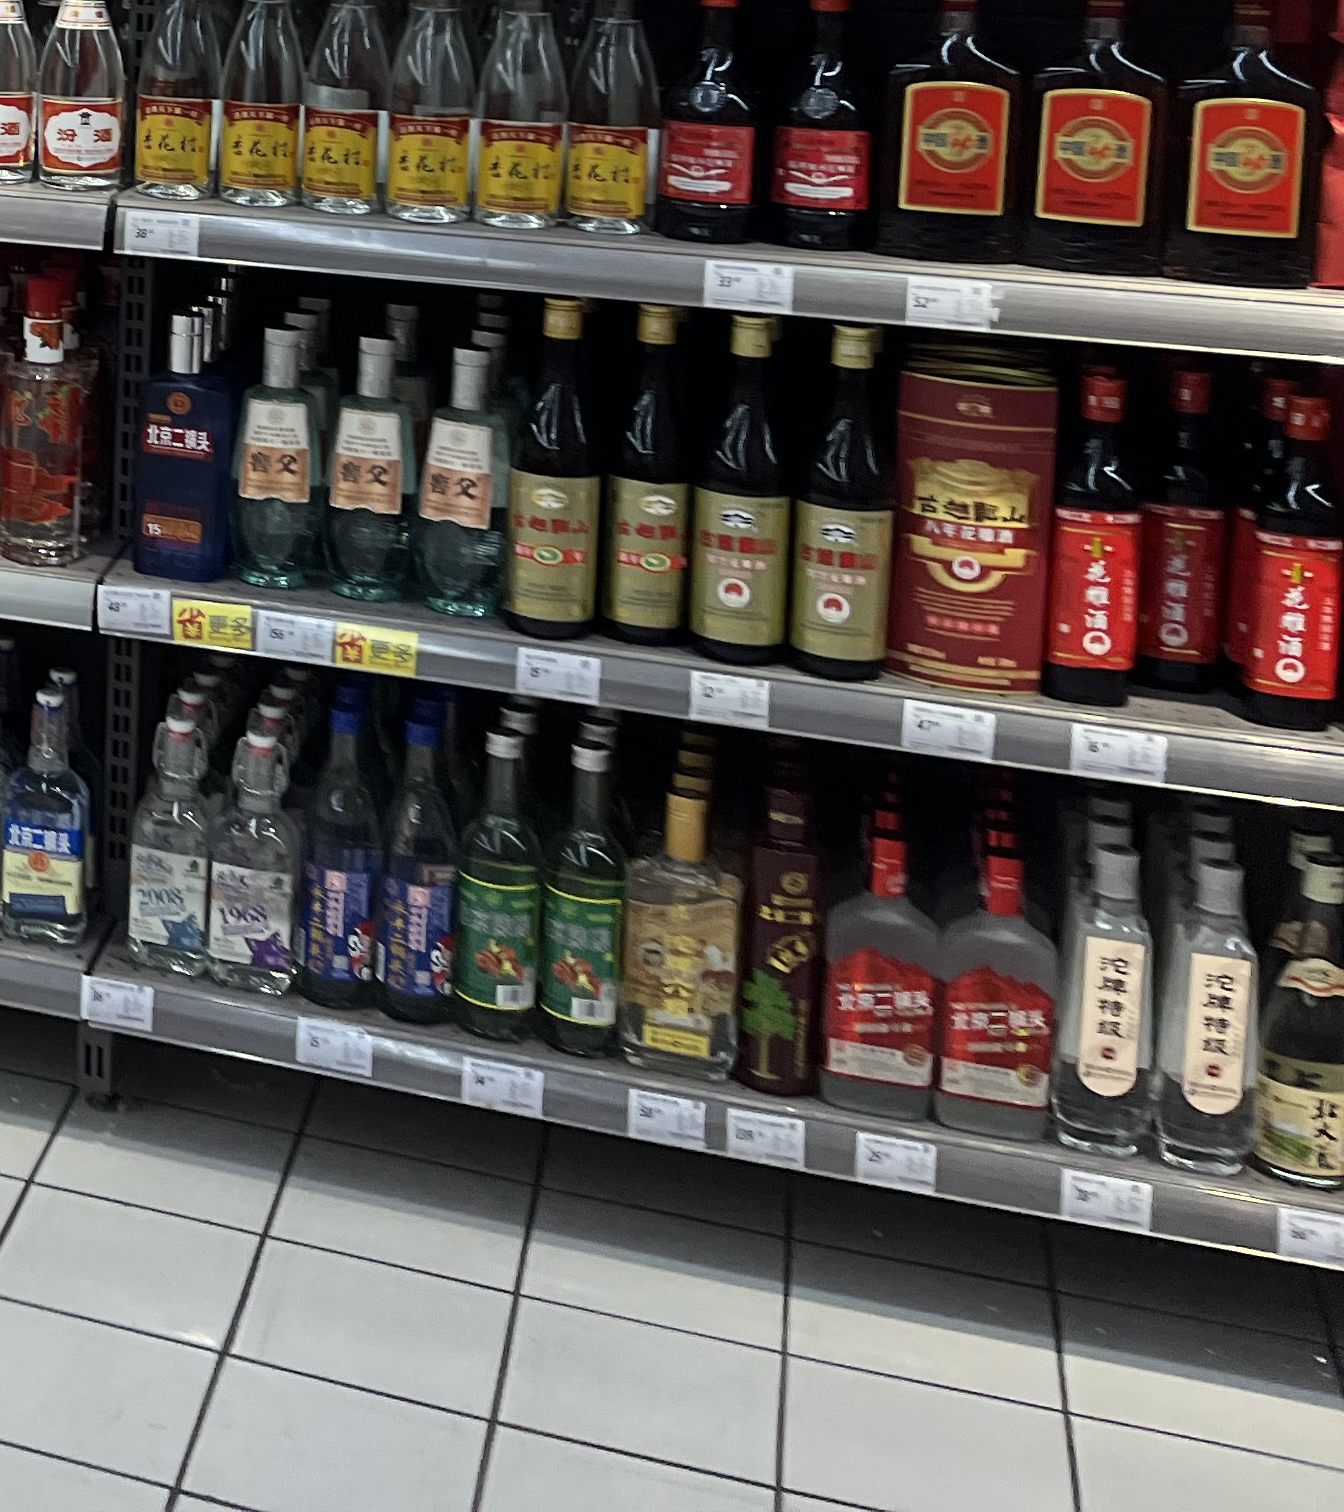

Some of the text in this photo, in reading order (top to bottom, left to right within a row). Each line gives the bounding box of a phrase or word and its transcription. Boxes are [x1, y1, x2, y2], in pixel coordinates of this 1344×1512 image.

[146, 424, 212, 454] 北京二锅头
[8, 821, 72, 855] 北京二锅头
[138, 888, 184, 910] 2008
[220, 905, 267, 928] 1968
